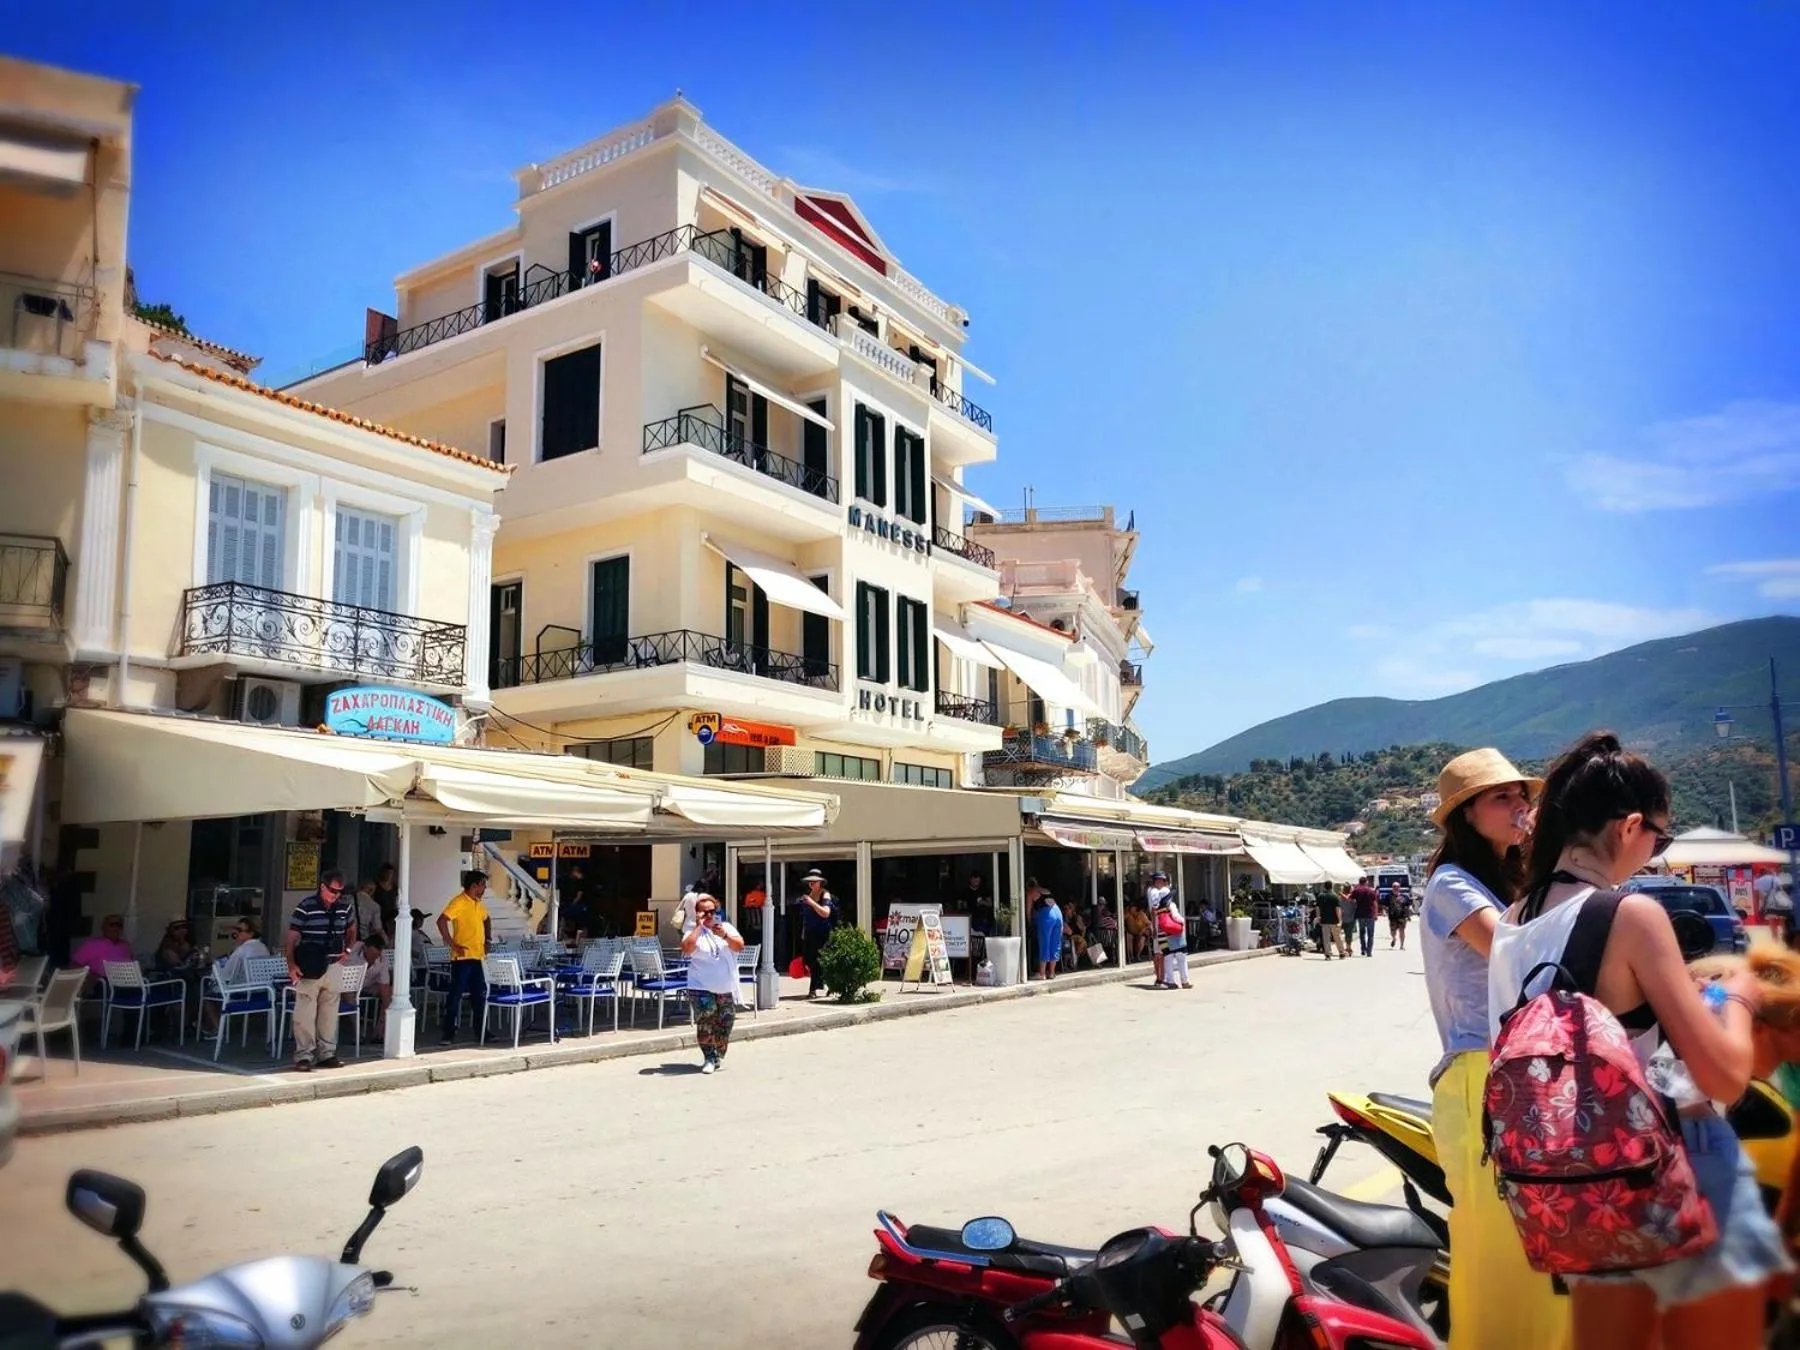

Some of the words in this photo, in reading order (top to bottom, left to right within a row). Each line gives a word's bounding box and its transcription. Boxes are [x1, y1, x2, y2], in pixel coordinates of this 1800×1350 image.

[848, 505, 932, 557] MANESSI
[859, 688, 925, 722] HOTEL
[694, 714, 716, 724] ATM
[1780, 827, 1795, 849] P
[562, 845, 588, 856] ATM
